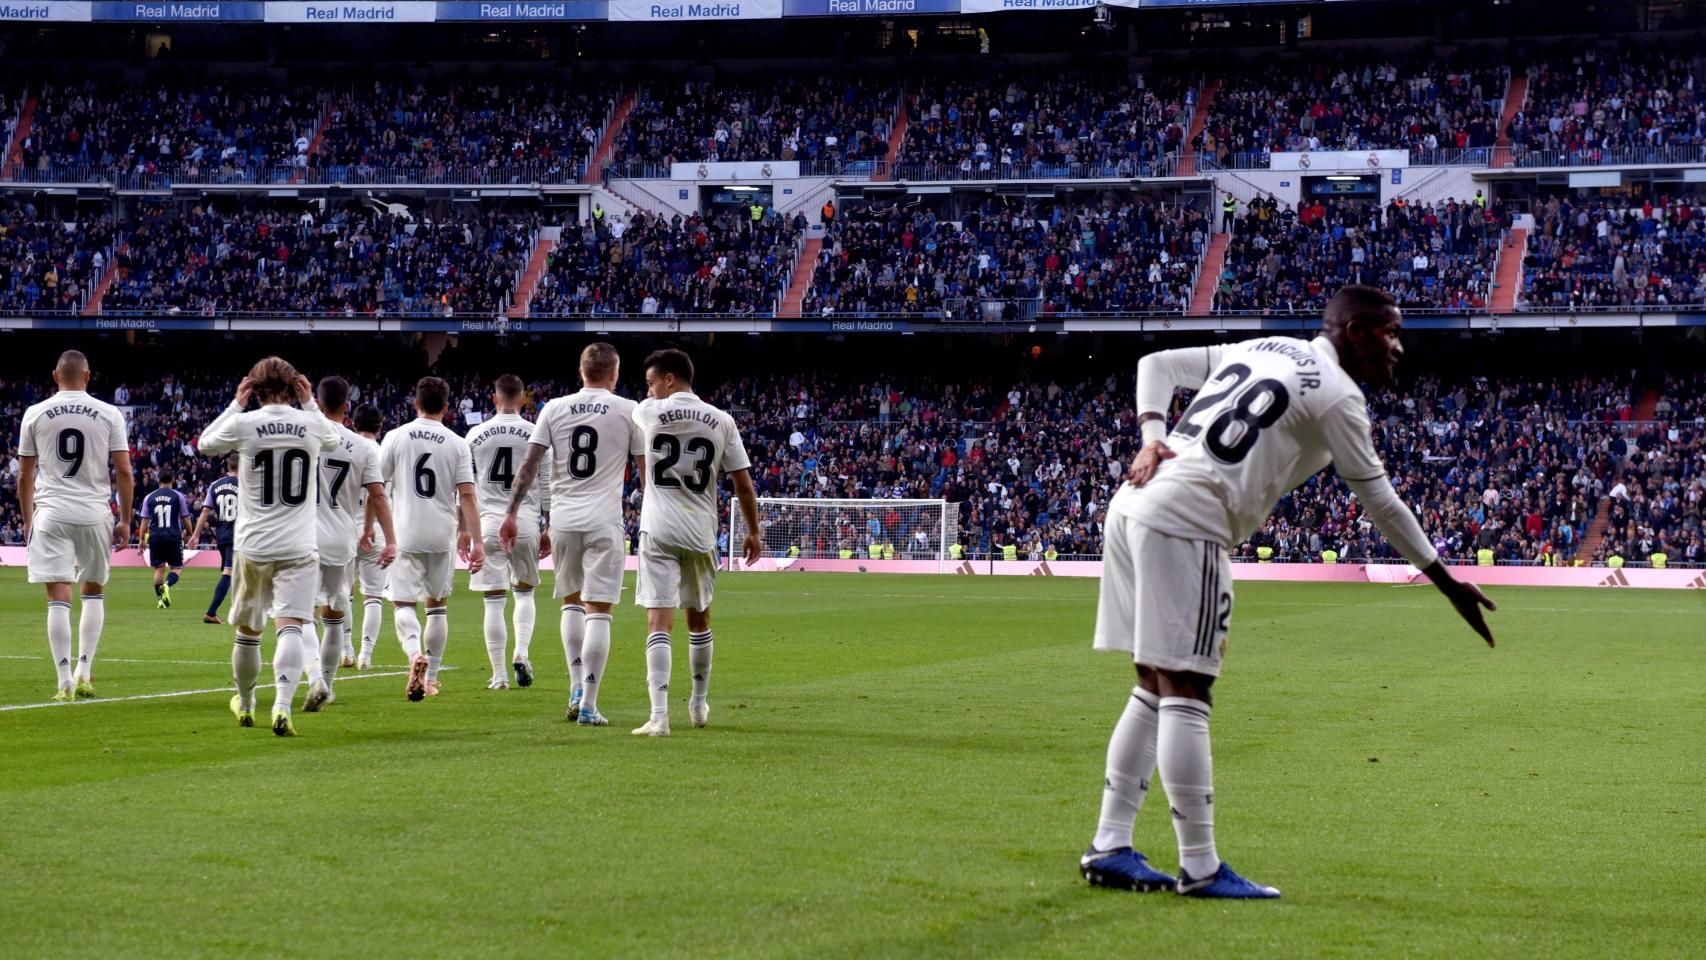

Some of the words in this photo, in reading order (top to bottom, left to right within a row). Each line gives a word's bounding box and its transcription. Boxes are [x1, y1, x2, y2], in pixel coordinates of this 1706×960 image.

[0, 6, 49, 18] Madrid
[135, 4, 166, 18] Real
[170, 4, 220, 17] Madrid
[306, 7, 338, 19] Real
[343, 6, 395, 19] Madrid
[480, 4, 511, 17] Real
[515, 4, 565, 17] Madrid
[651, 5, 683, 18] Real
[688, 4, 740, 17] Madrid
[829, 0, 860, 12] Real
[865, 0, 915, 11] Madrid
[96, 319, 118, 328] Real
[120, 318, 155, 328] Madrid
[462, 320, 484, 330] Real
[487, 320, 522, 330] Mrid
[832, 321, 854, 330] Real
[857, 320, 893, 330] Madrid
[1295, 370, 1321, 396] JR.
[46, 404, 100, 421] BENZEMA
[570, 403, 610, 415] KROOS
[1168, 362, 1289, 466] 28
[658, 408, 719, 430] REGUILÓN
[409, 430, 446, 445] NACHO
[472, 426, 507, 447] SERGIO
[508, 426, 531, 442] RAM
[56, 428, 85, 478] 9
[568, 424, 599, 480] 8
[488, 446, 515, 492] 4
[650, 432, 715, 494] 23
[252, 448, 311, 507] 10
[413, 452, 436, 500] 6
[153, 504, 172, 528] 11
[216, 494, 238, 522] 18
